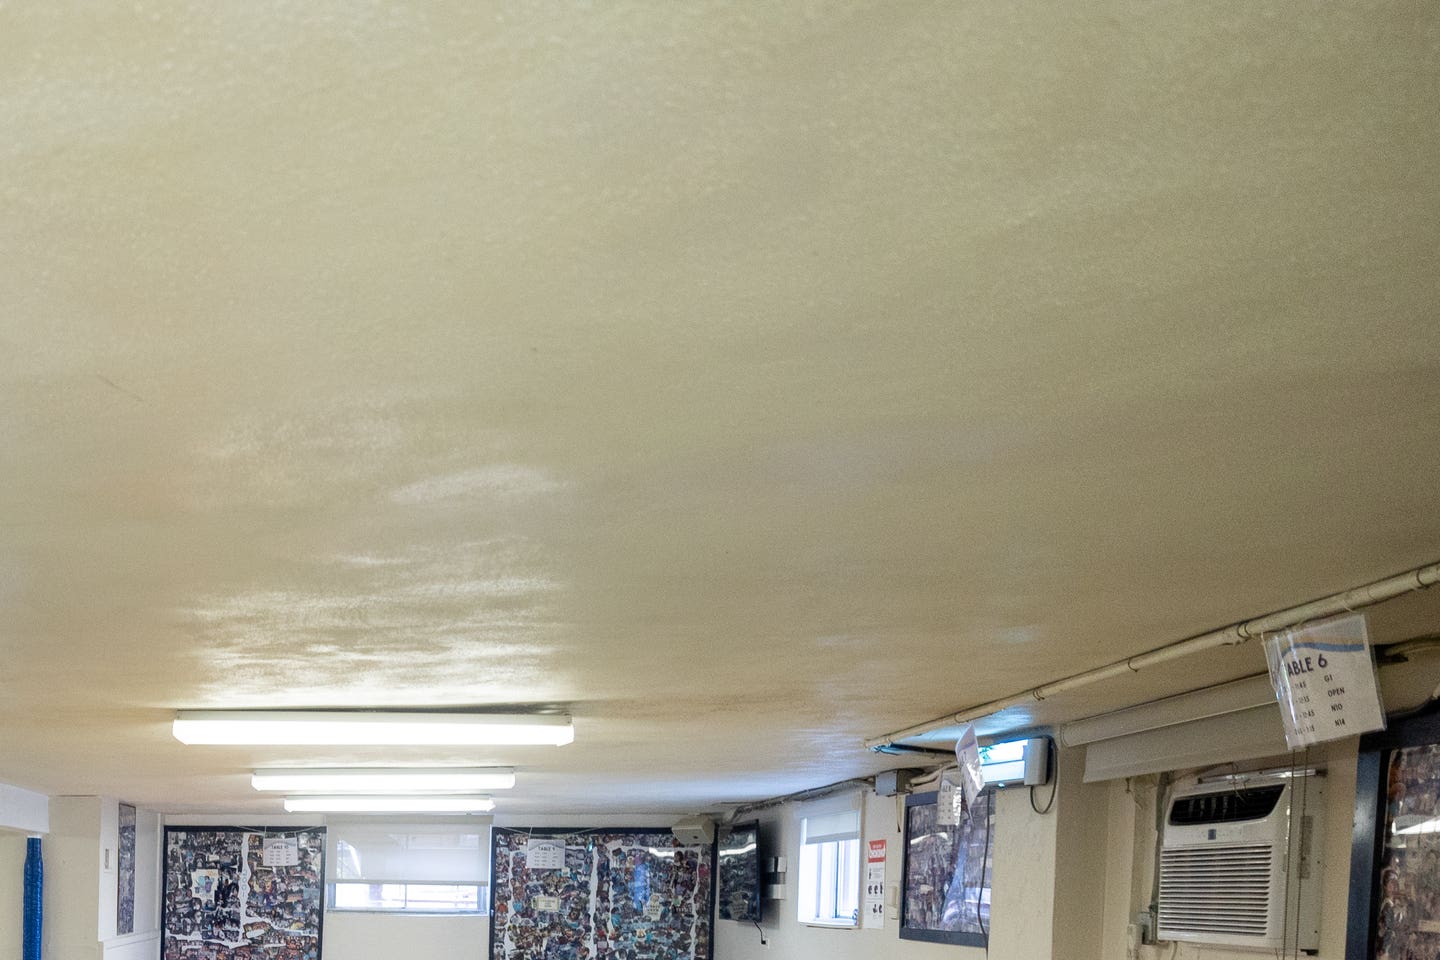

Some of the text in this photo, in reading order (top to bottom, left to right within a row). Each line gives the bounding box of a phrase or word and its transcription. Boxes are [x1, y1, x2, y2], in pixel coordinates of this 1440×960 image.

[1286, 654, 1328, 677] ABLE 6
[1327, 687, 1345, 698] OPEN
